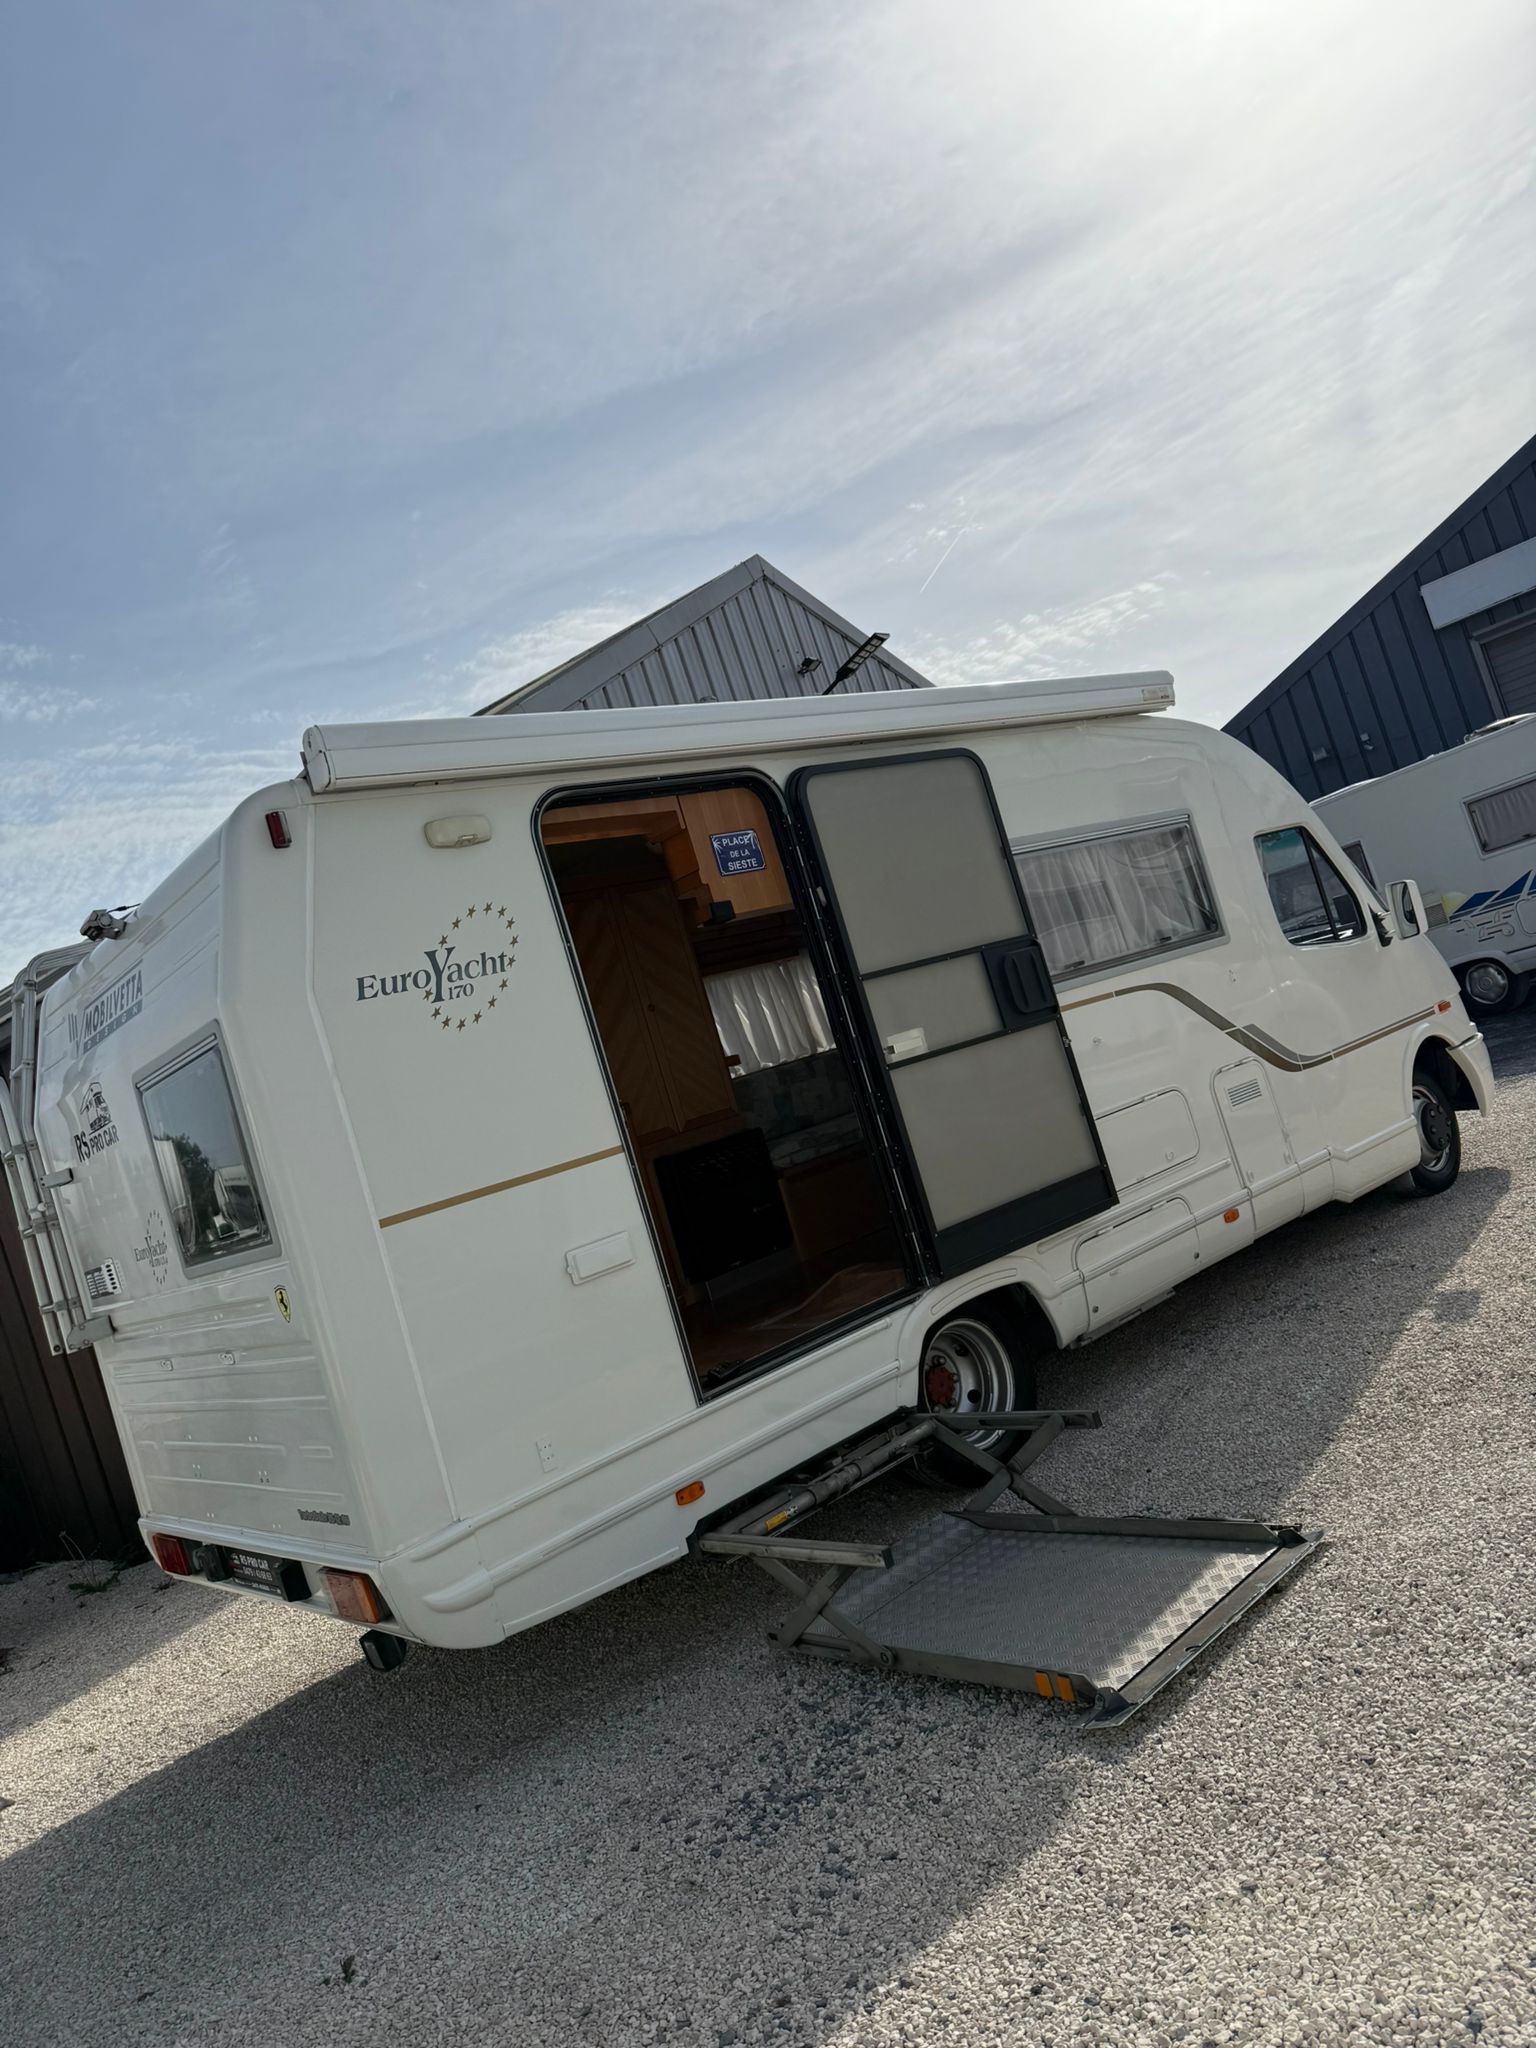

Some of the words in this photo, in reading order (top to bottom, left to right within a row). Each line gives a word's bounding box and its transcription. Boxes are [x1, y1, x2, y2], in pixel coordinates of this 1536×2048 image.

[721, 835, 750, 847] PLACE
[729, 850, 740, 858] DE
[740, 849, 751, 857] LA
[727, 858, 758, 871] SIESTE
[356, 946, 508, 1004] EuroYacht
[448, 983, 475, 1000] 170
[84, 969, 143, 1040] MOBILVETTA
[73, 1130, 91, 1163] RS
[89, 1132, 105, 1156] PRO
[102, 1124, 120, 1148] CAR
